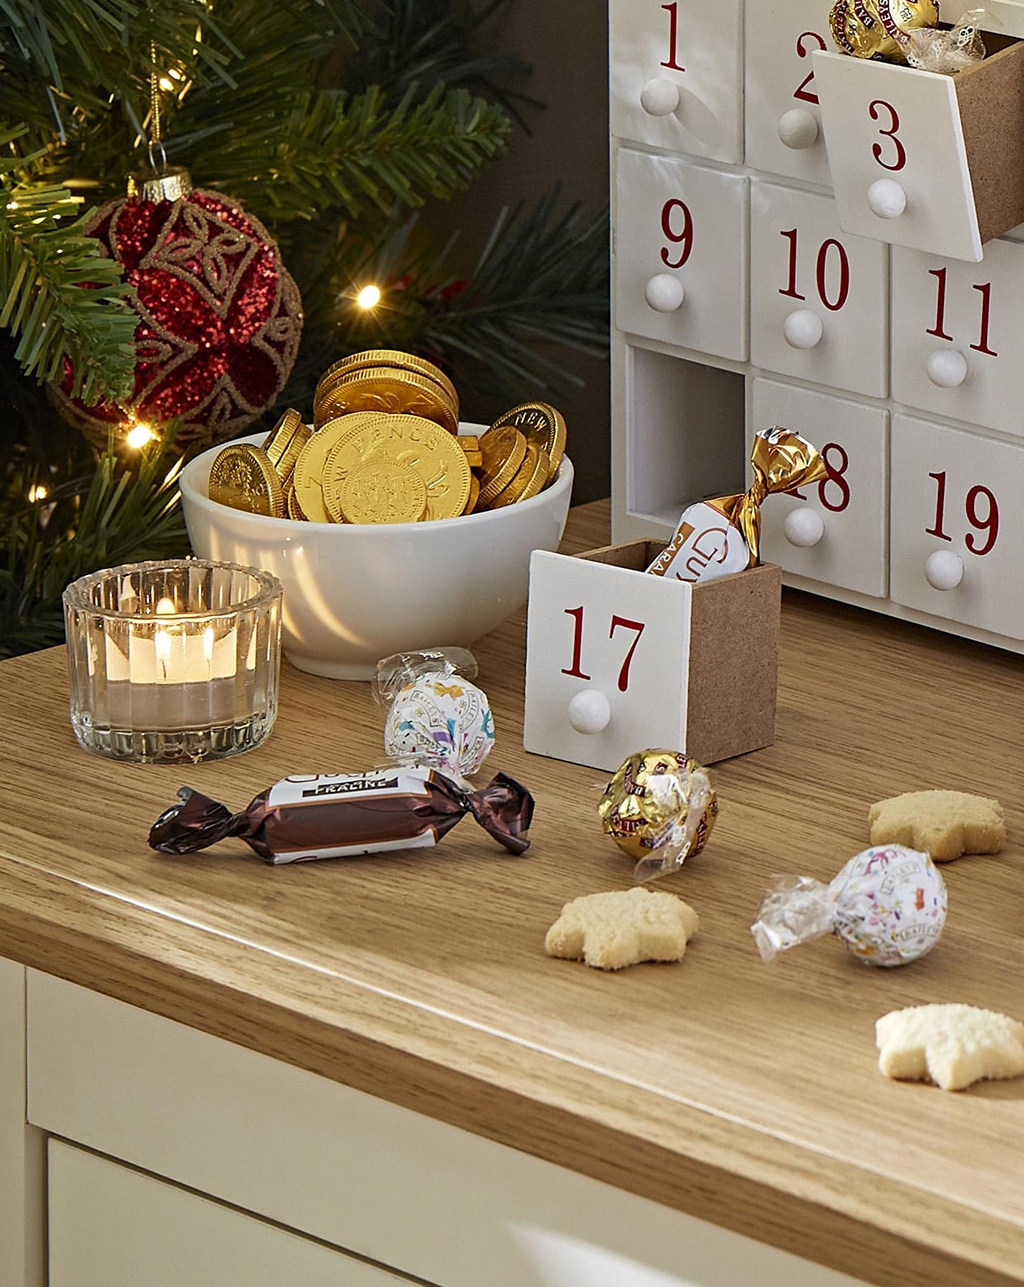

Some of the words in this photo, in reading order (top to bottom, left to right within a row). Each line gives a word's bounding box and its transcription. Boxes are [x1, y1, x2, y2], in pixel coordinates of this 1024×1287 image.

[662, 2, 684, 71] 1
[793, 32, 827, 104] 2
[869, 100, 905, 171] 3
[660, 199, 693, 268] 9
[778, 228, 849, 311] 10
[926, 268, 995, 355] 11
[350, 423, 440, 454] PENCE
[783, 443, 850, 512] 8
[926, 473, 998, 555] 19
[651, 532, 684, 576] CARA
[560, 607, 644, 691] 17
[314, 778, 388, 795] PRALINE
